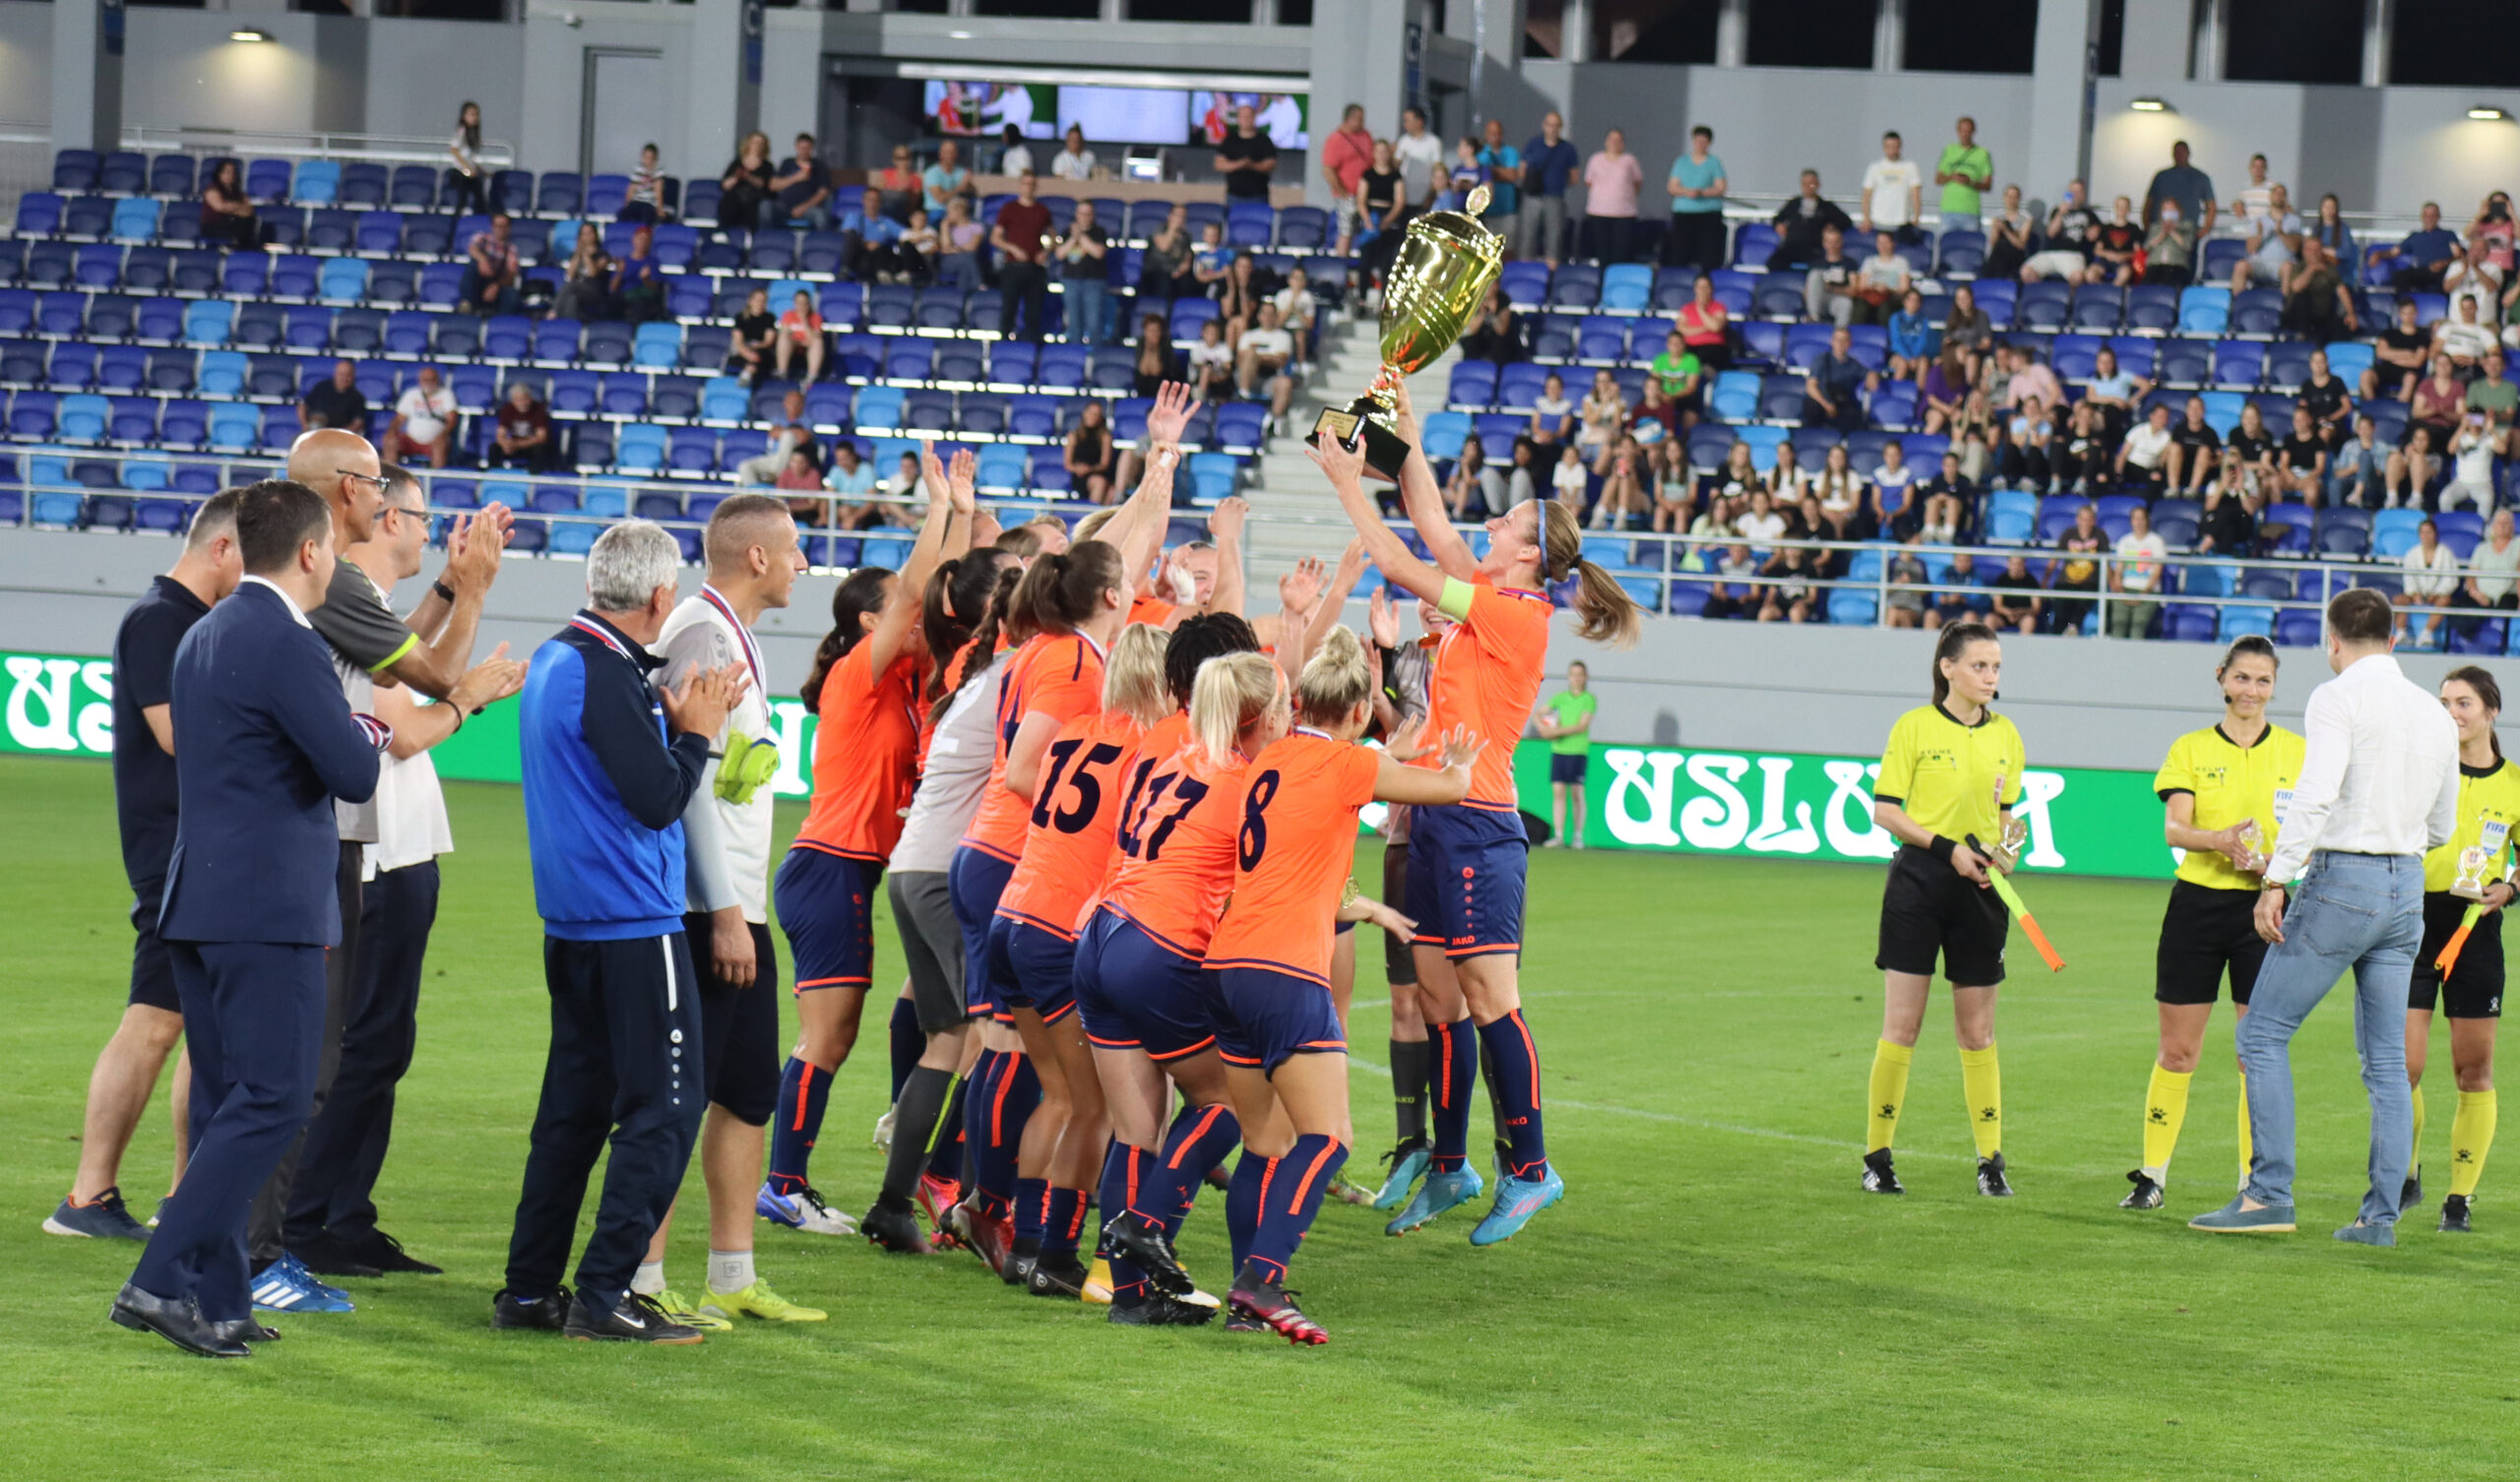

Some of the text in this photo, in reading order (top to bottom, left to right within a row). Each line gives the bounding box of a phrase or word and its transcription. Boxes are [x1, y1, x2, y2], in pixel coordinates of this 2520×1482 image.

[1031, 738, 1124, 834] 15
[1127, 770, 1210, 862] 17
[1238, 770, 1280, 873] 8
[1505, 1116, 1529, 1126] AKO
